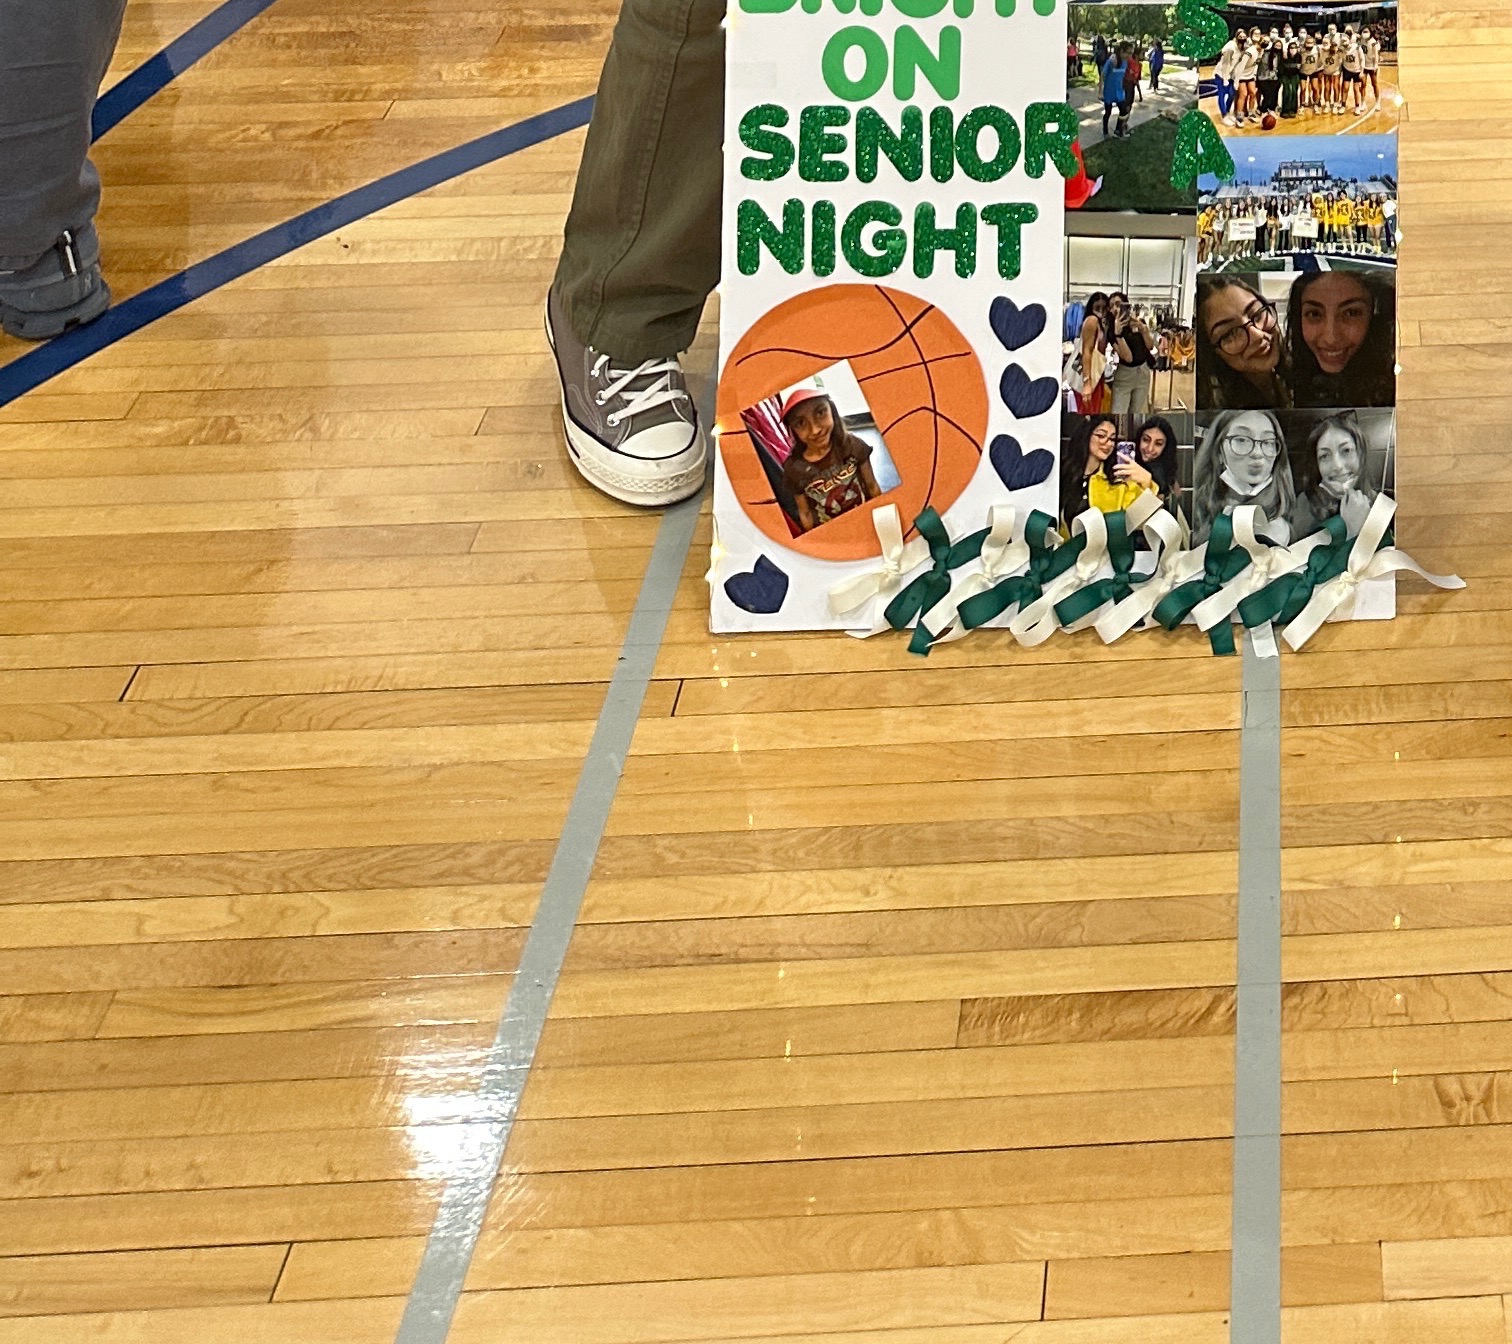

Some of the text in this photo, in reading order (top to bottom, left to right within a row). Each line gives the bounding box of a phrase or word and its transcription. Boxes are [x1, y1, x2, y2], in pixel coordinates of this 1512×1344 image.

[821, 25, 961, 101] ON
[738, 103, 1080, 183] SENIOR
[736, 199, 1039, 280] NIGHT
